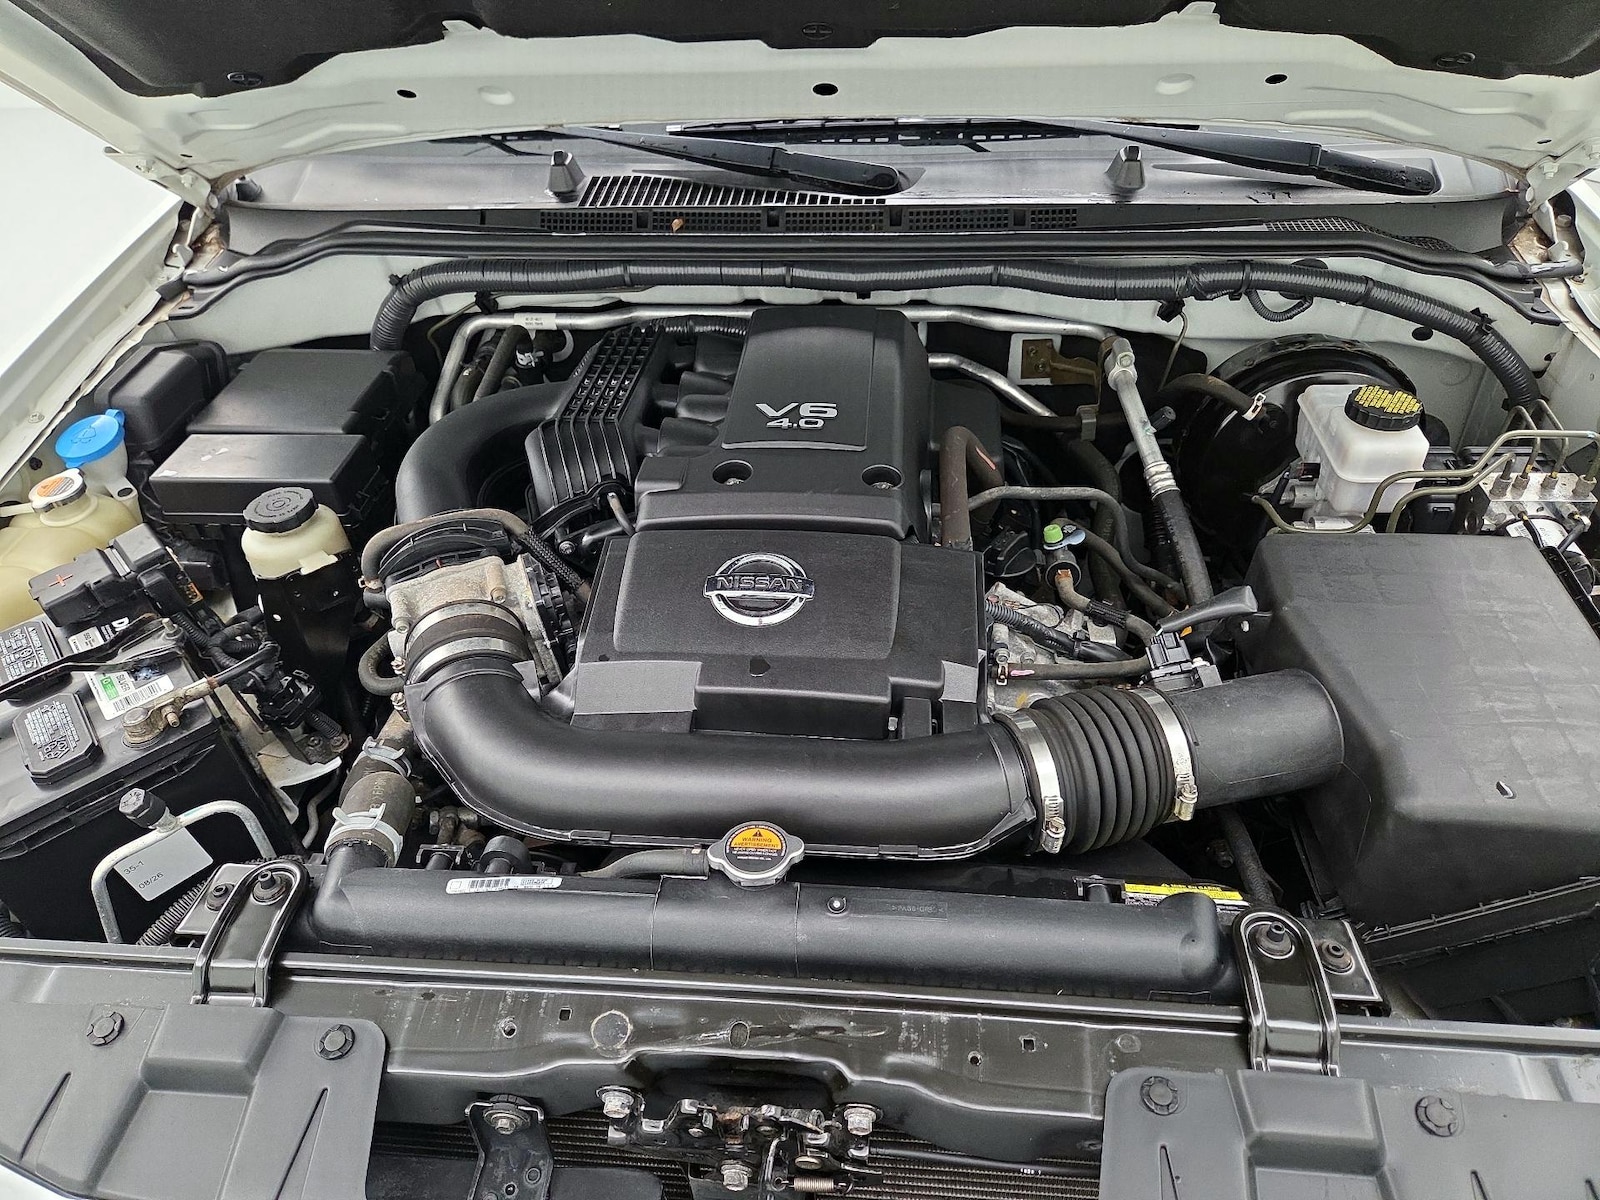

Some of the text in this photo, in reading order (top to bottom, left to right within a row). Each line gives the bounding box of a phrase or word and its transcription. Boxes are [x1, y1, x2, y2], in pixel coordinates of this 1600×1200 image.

[755, 402, 838, 419] V6
[766, 417, 825, 430] 4.0
[716, 576, 803, 591] NISSAN
[138, 871, 165, 890] 08/26
